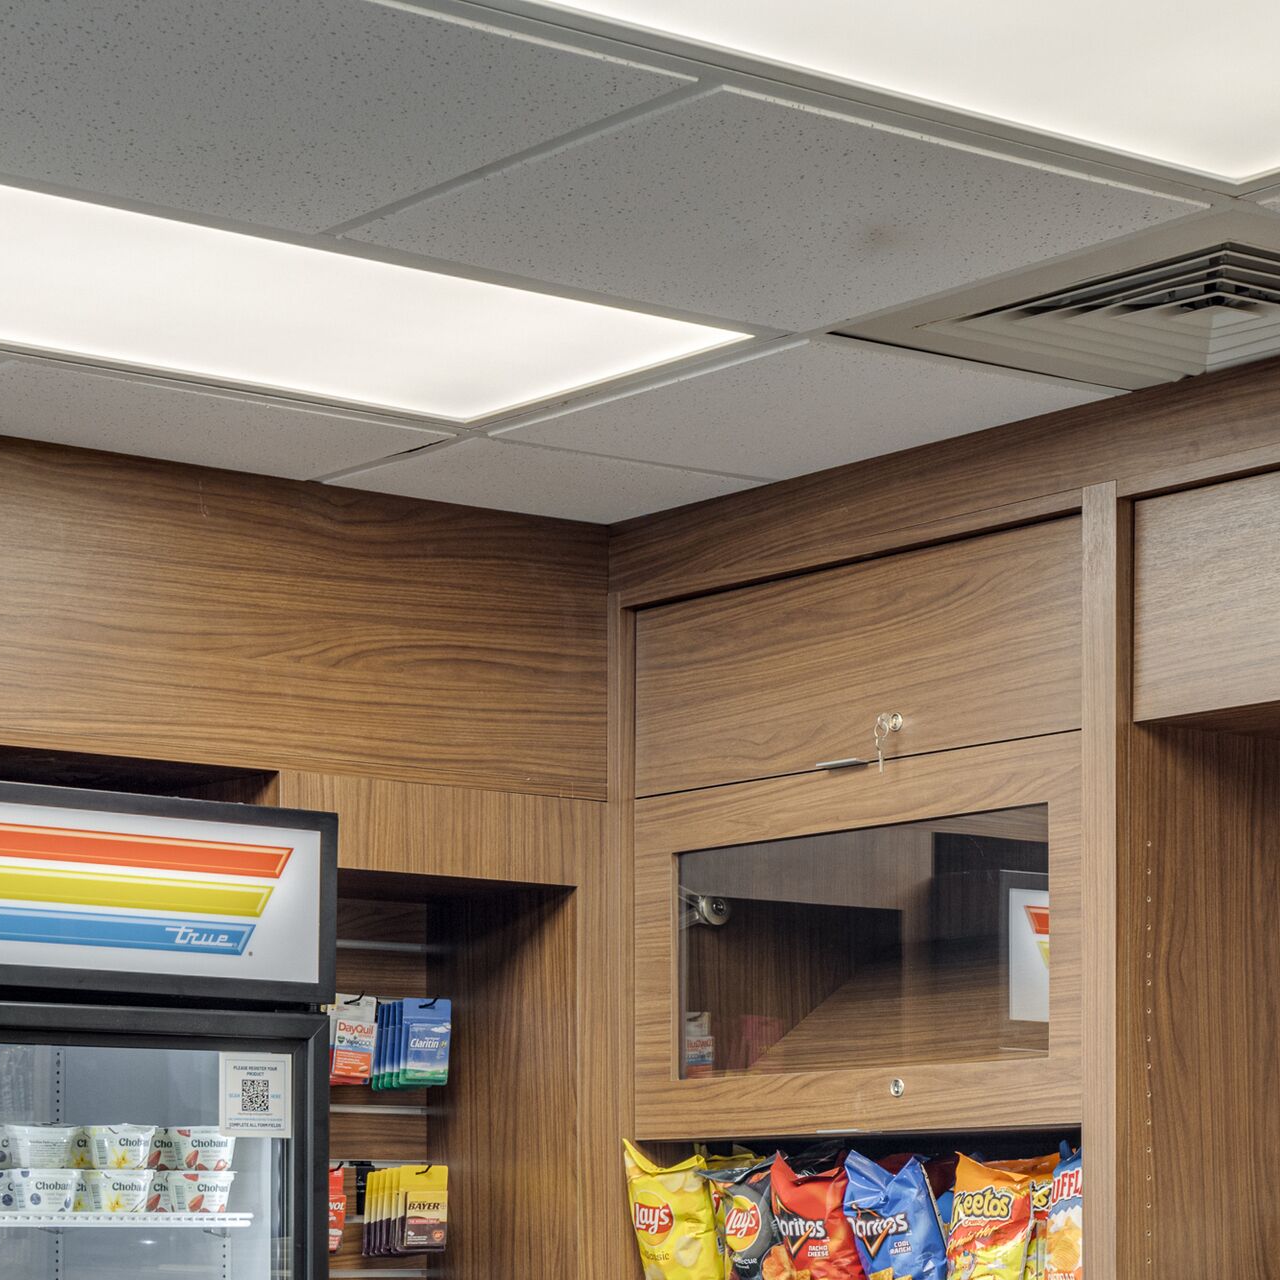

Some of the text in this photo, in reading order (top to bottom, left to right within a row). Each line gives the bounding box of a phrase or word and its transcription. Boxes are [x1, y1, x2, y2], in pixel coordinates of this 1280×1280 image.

[338, 1021, 374, 1035] DayQuil
[410, 1038, 439, 1049] Claritin
[191, 1139, 228, 1148] Chobani
[408, 1202, 440, 1210] BAYER
[635, 1202, 670, 1235] Lay's
[726, 1204, 757, 1238] Lay's
[890, 1246, 912, 1255] RANCH
